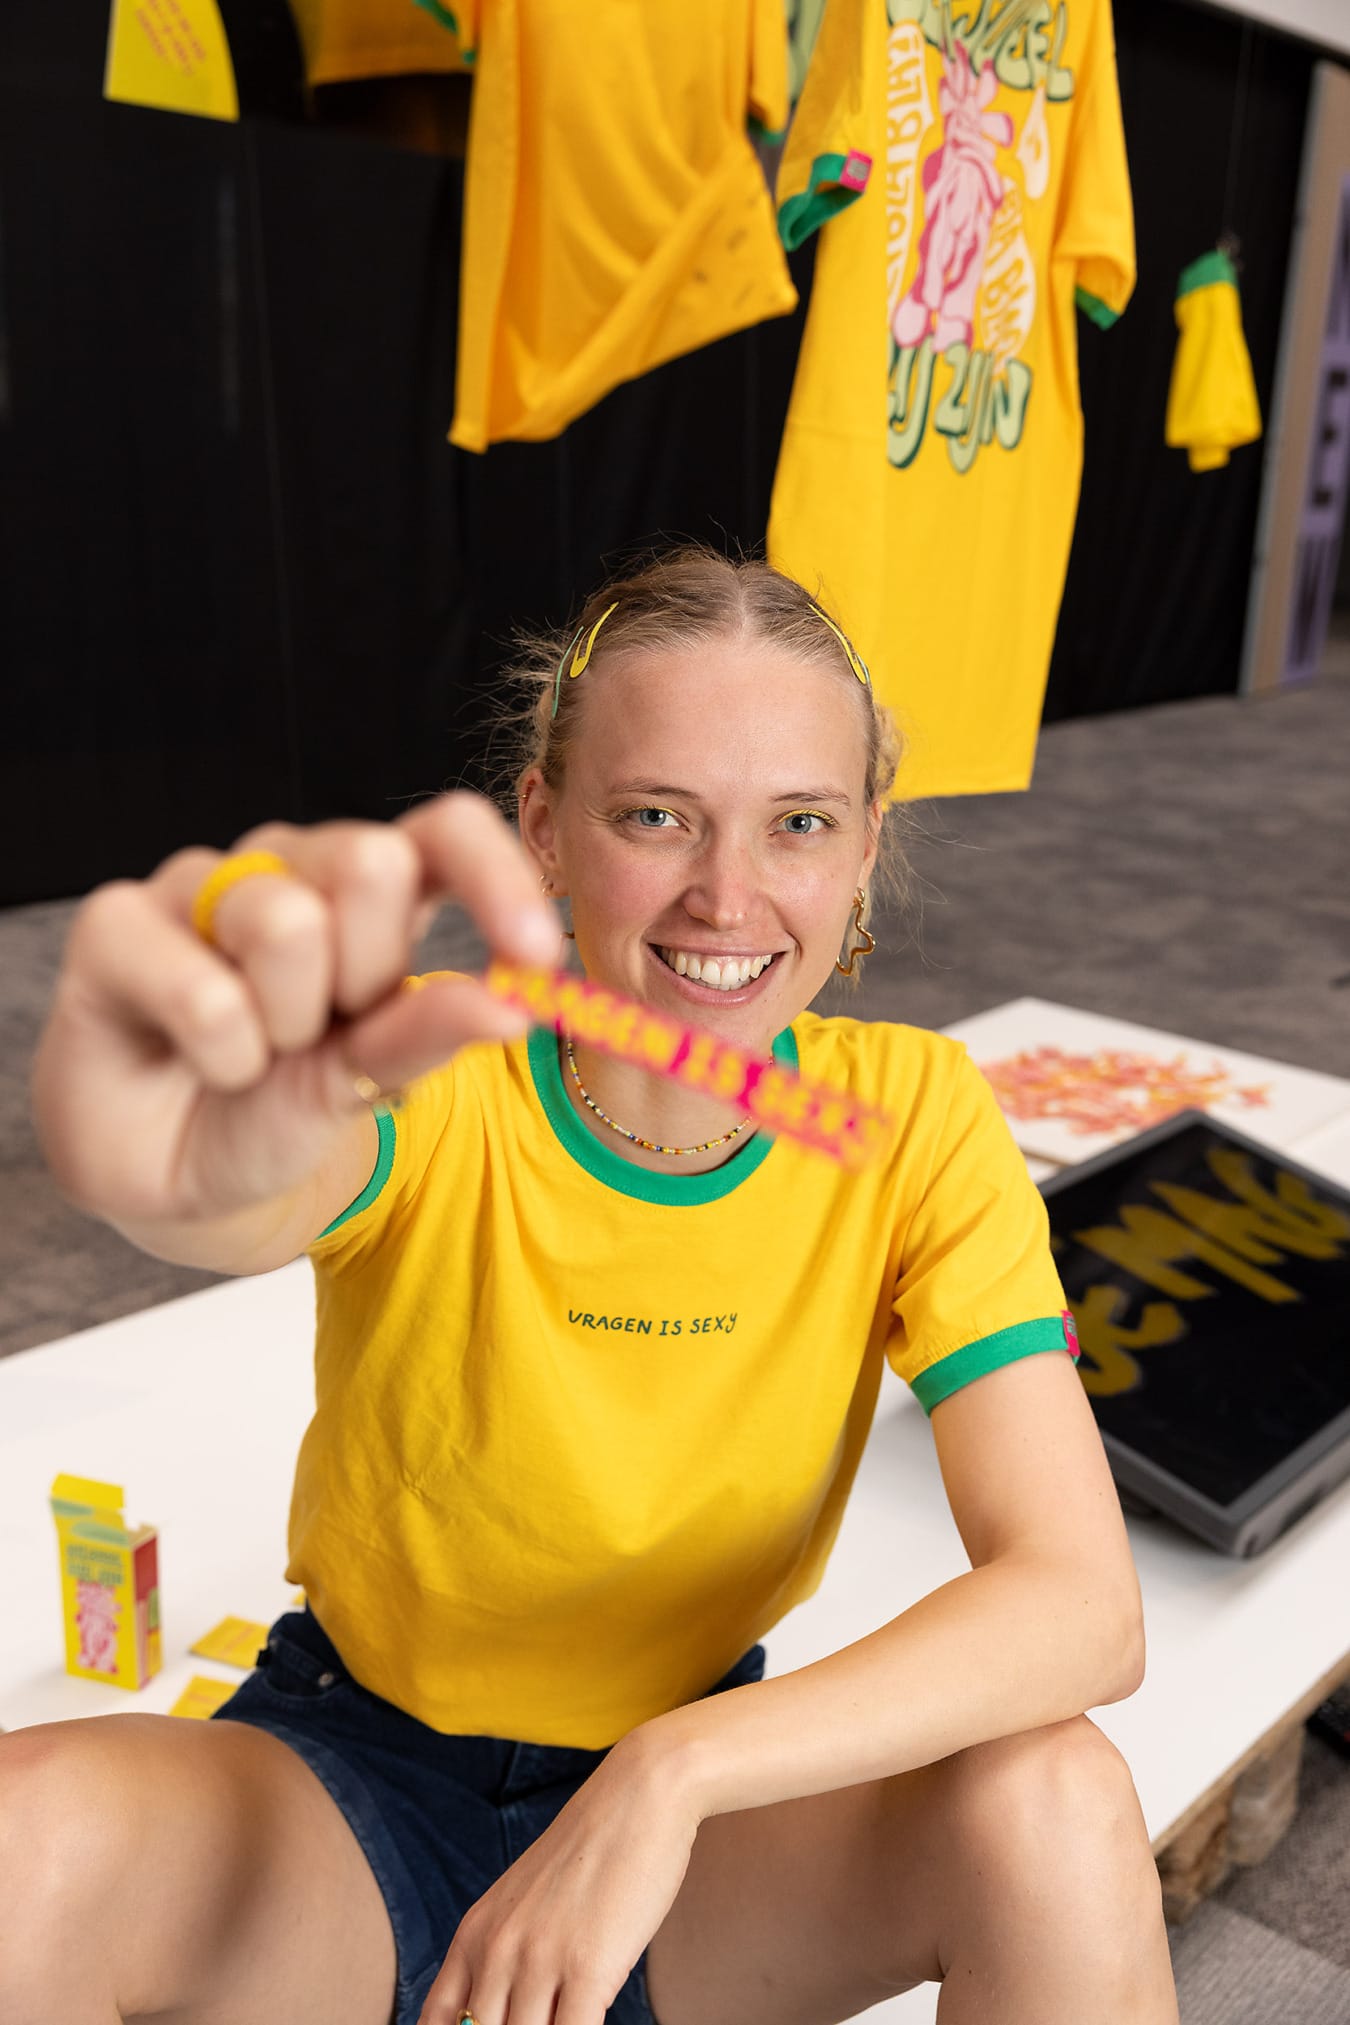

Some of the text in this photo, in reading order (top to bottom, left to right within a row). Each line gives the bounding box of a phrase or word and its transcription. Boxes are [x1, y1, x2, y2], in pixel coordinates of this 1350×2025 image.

[568, 1309, 738, 1336] VRAGEN IS SEXY
